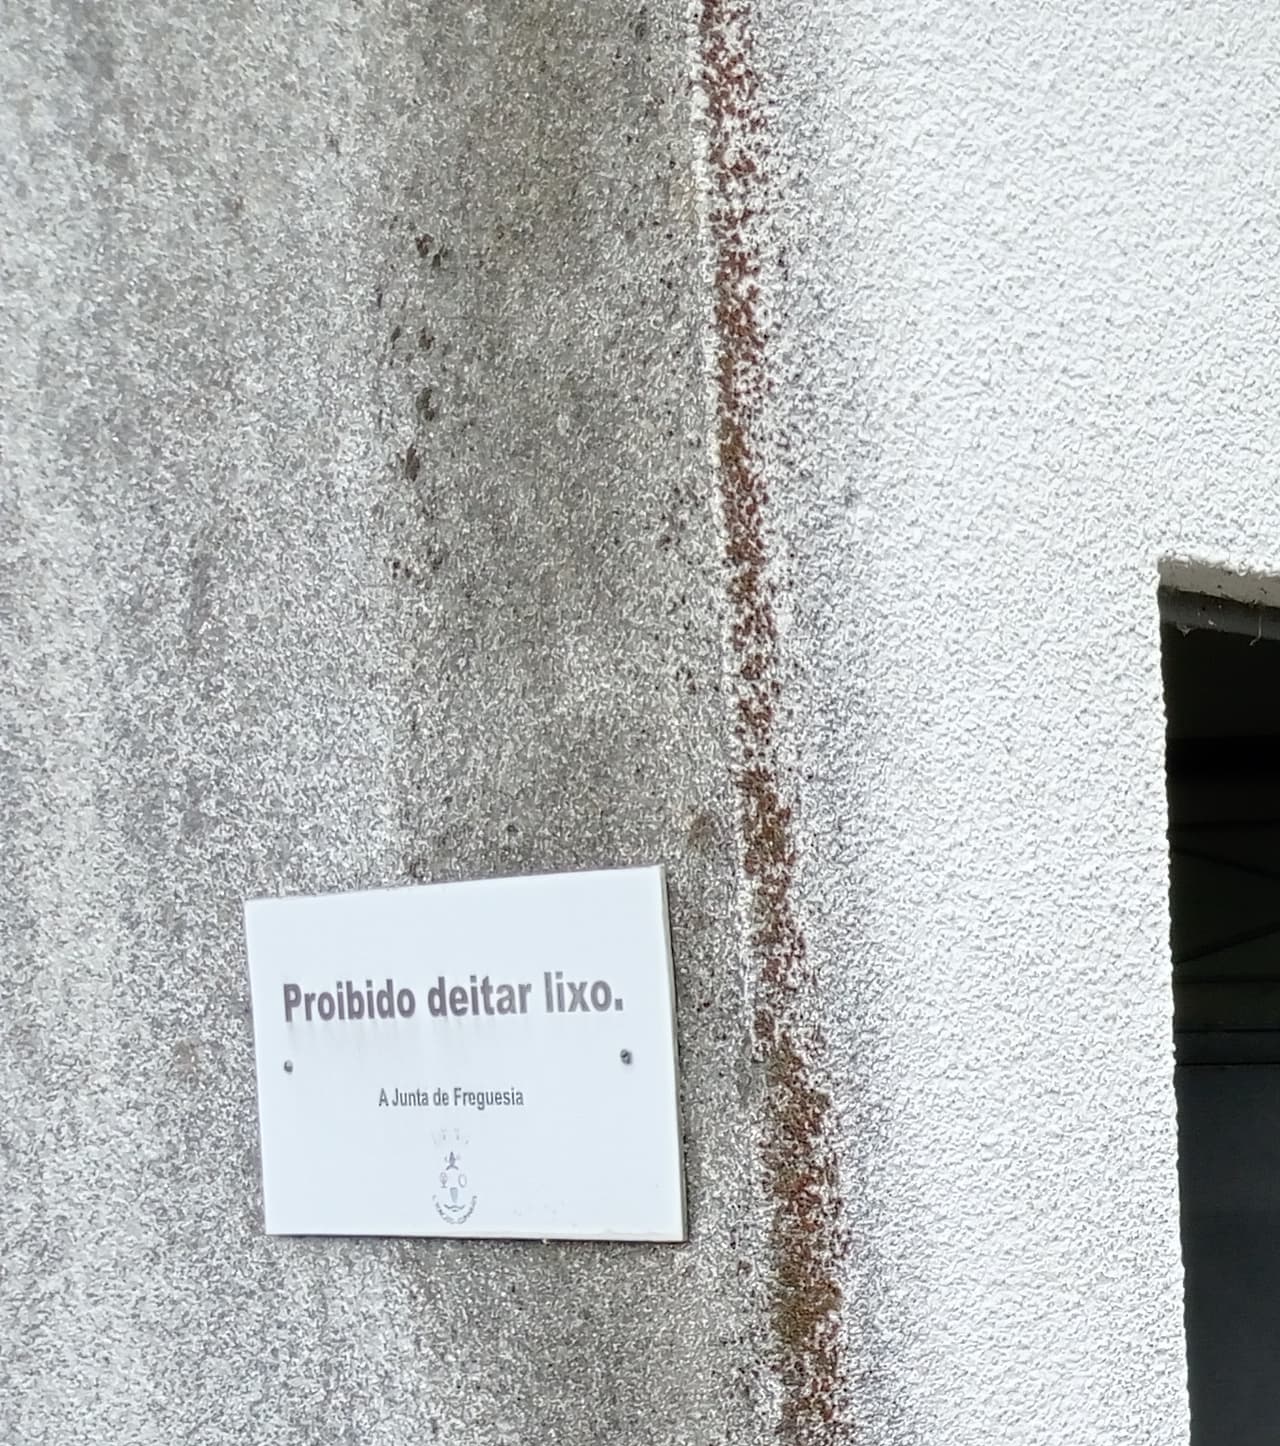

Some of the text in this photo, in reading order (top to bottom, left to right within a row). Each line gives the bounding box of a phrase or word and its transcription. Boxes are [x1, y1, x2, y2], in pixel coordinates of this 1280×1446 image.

[283, 971, 624, 1023] Proibido deitar lixo.
[378, 1086, 524, 1111] A Junta de Freguesia
